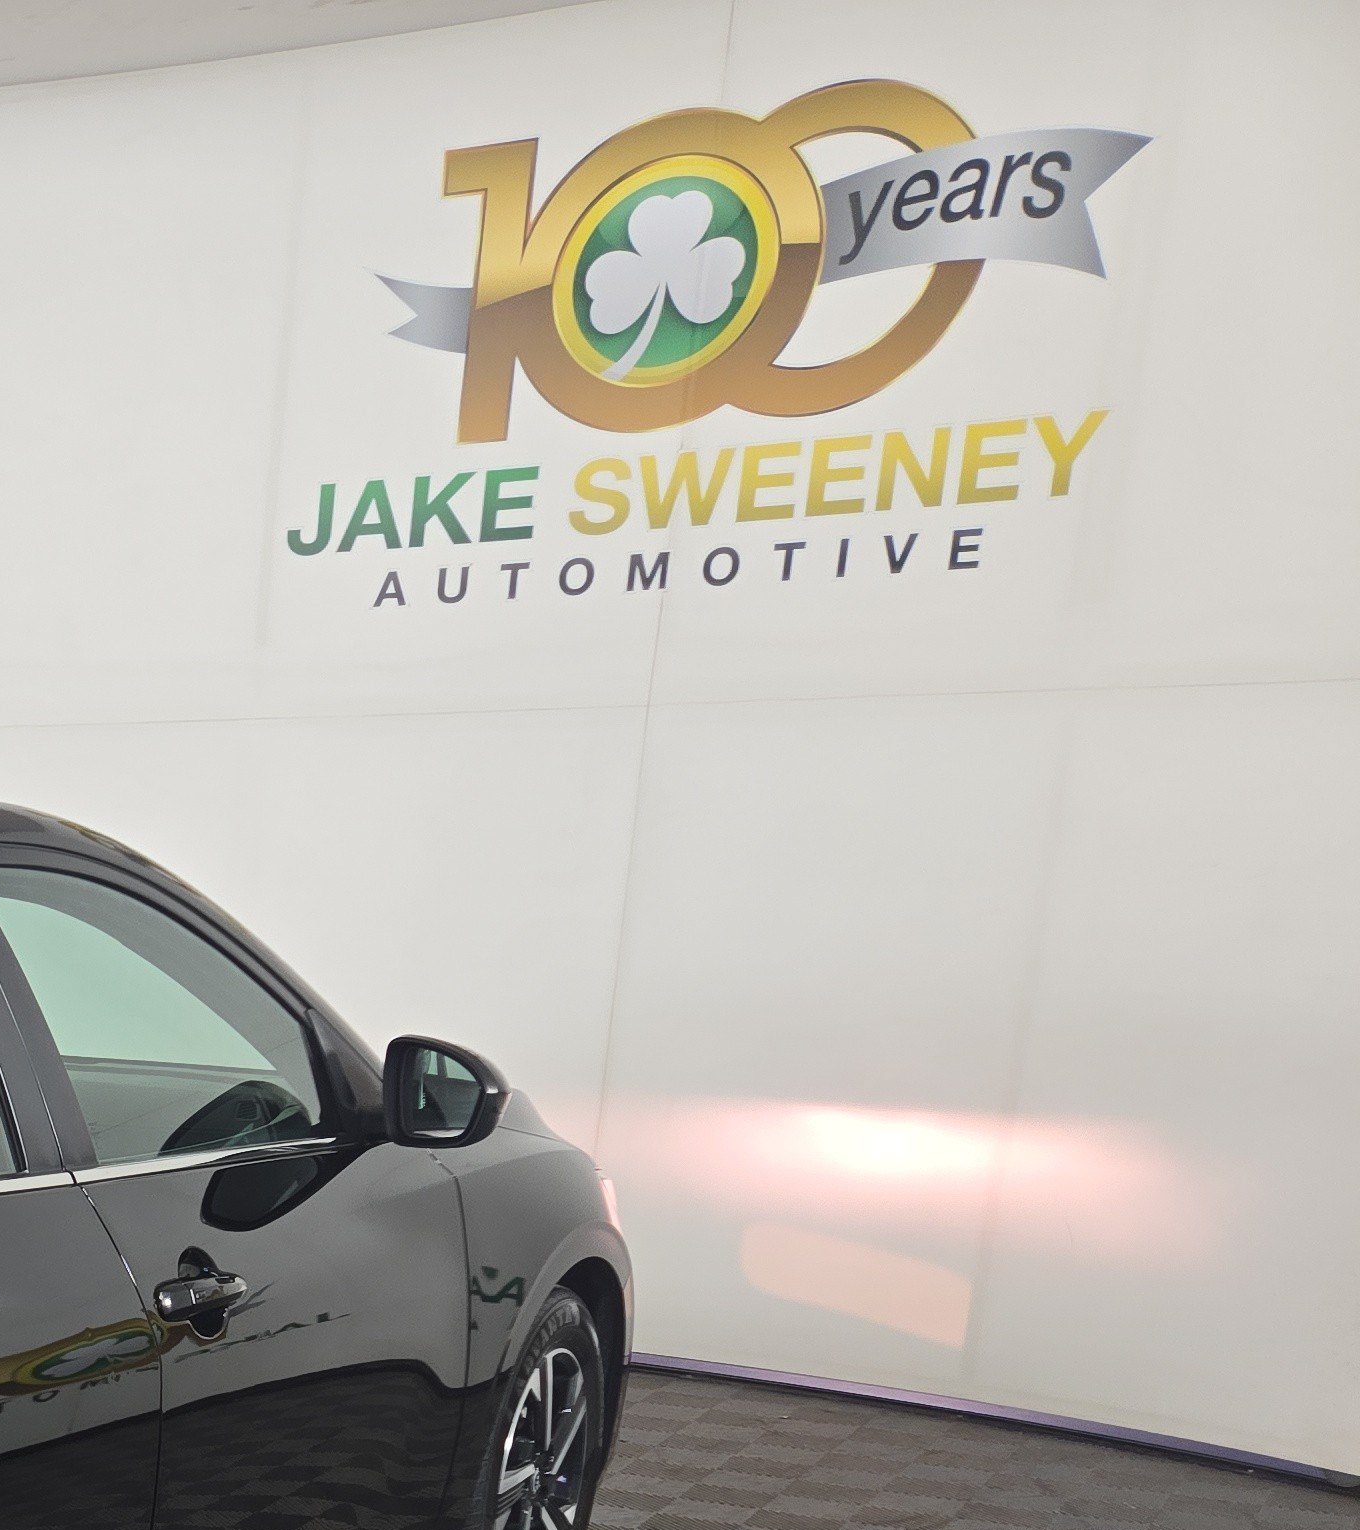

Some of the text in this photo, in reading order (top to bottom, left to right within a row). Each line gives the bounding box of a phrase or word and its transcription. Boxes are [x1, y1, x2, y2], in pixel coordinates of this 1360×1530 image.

[443, 78, 1073, 443] 100 years
[286, 410, 1110, 556] JAKE SWEENEY
[372, 527, 985, 609] AUTOMOTIVE
